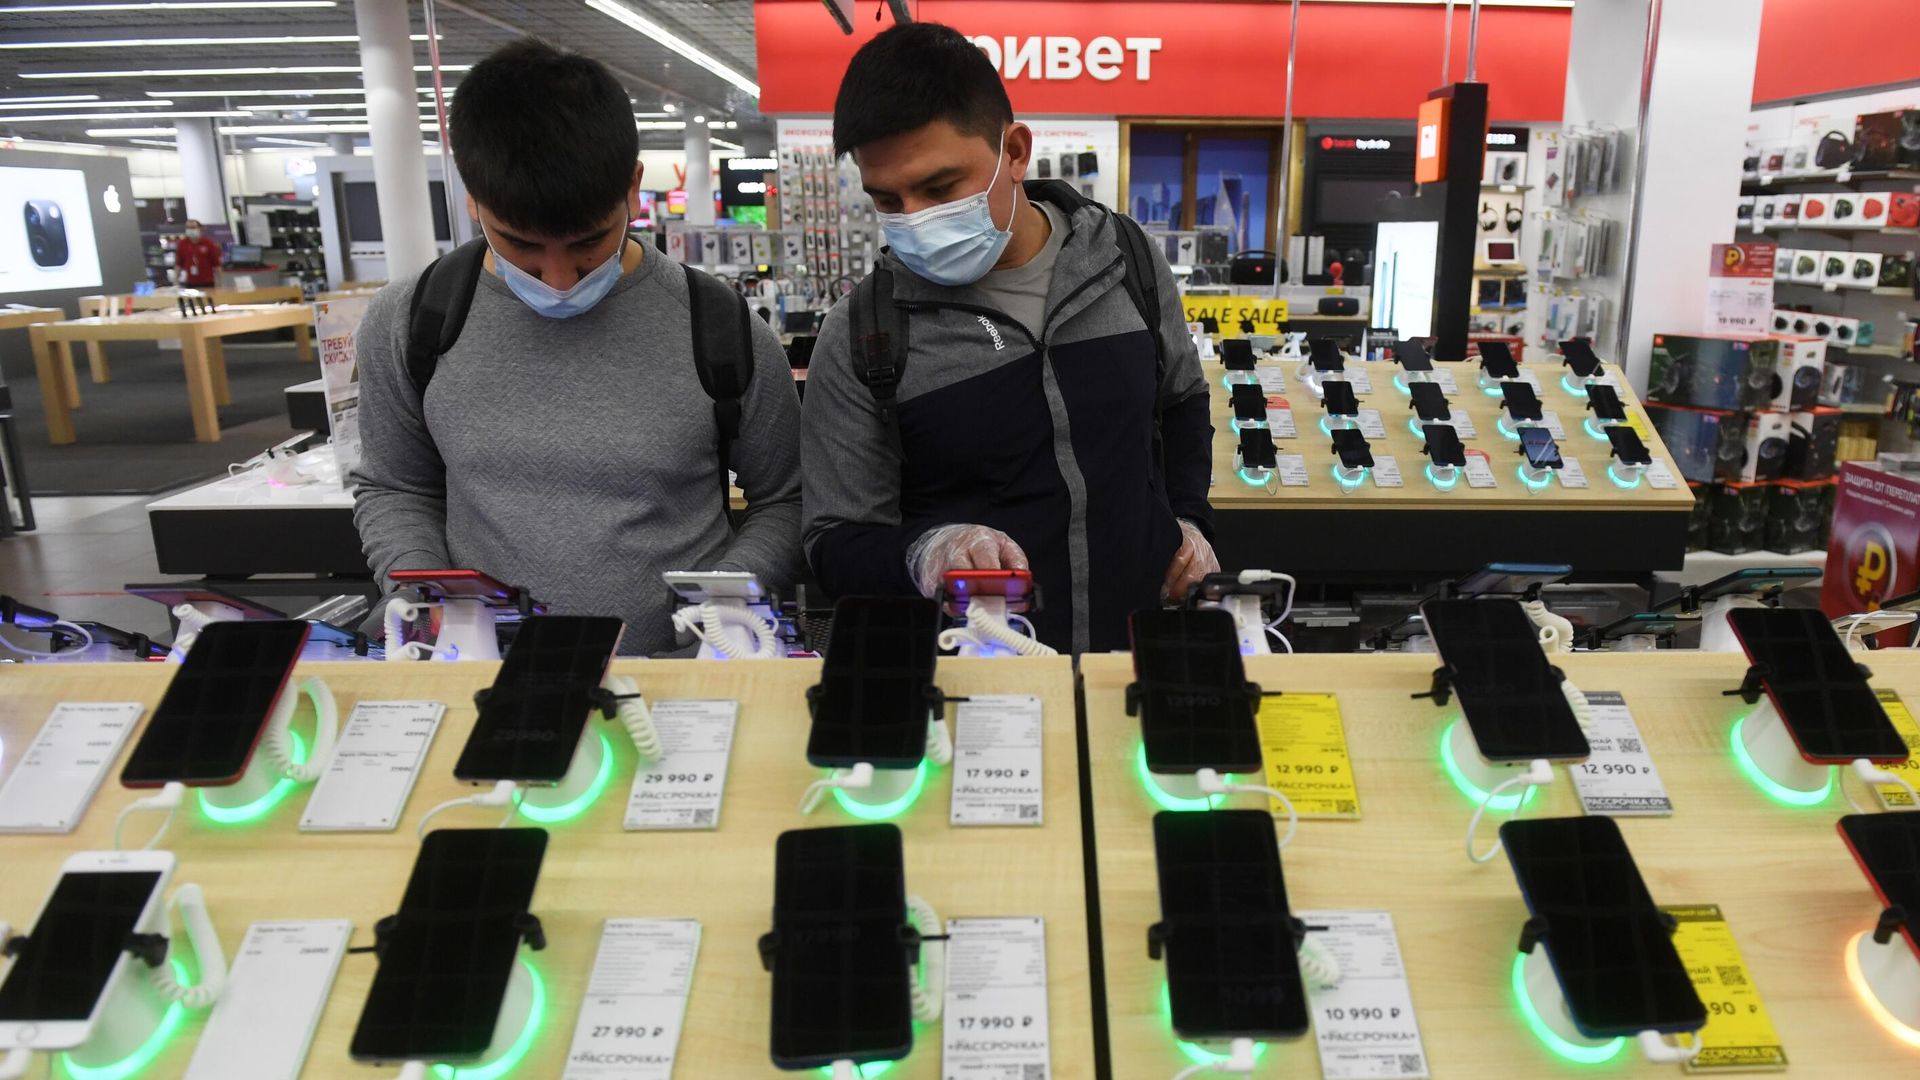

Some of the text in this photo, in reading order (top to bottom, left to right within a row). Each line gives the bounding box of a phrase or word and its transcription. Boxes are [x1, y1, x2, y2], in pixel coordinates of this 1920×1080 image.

[965, 35, 1162, 80] ривет
[1186, 308, 1285, 324] SALE SALE
[976, 314, 1005, 351] Reebok
[967, 769, 980, 778] 17
[984, 769, 1013, 778] 990
[1276, 765, 1290, 774] 12
[1295, 765, 1323, 774] 990
[1581, 764, 1599, 774] 12
[1603, 764, 1636, 775] 990
[645, 774, 663, 784] 29
[668, 774, 697, 783] 990
[1325, 1008, 1344, 1020] 10
[1350, 1008, 1383, 1020] 990
[1708, 1002, 1736, 1015] 90
[959, 1017, 975, 1029] 17
[980, 1017, 1014, 1028] 990
[592, 1026, 611, 1037] 27
[615, 1027, 646, 1037] 990
